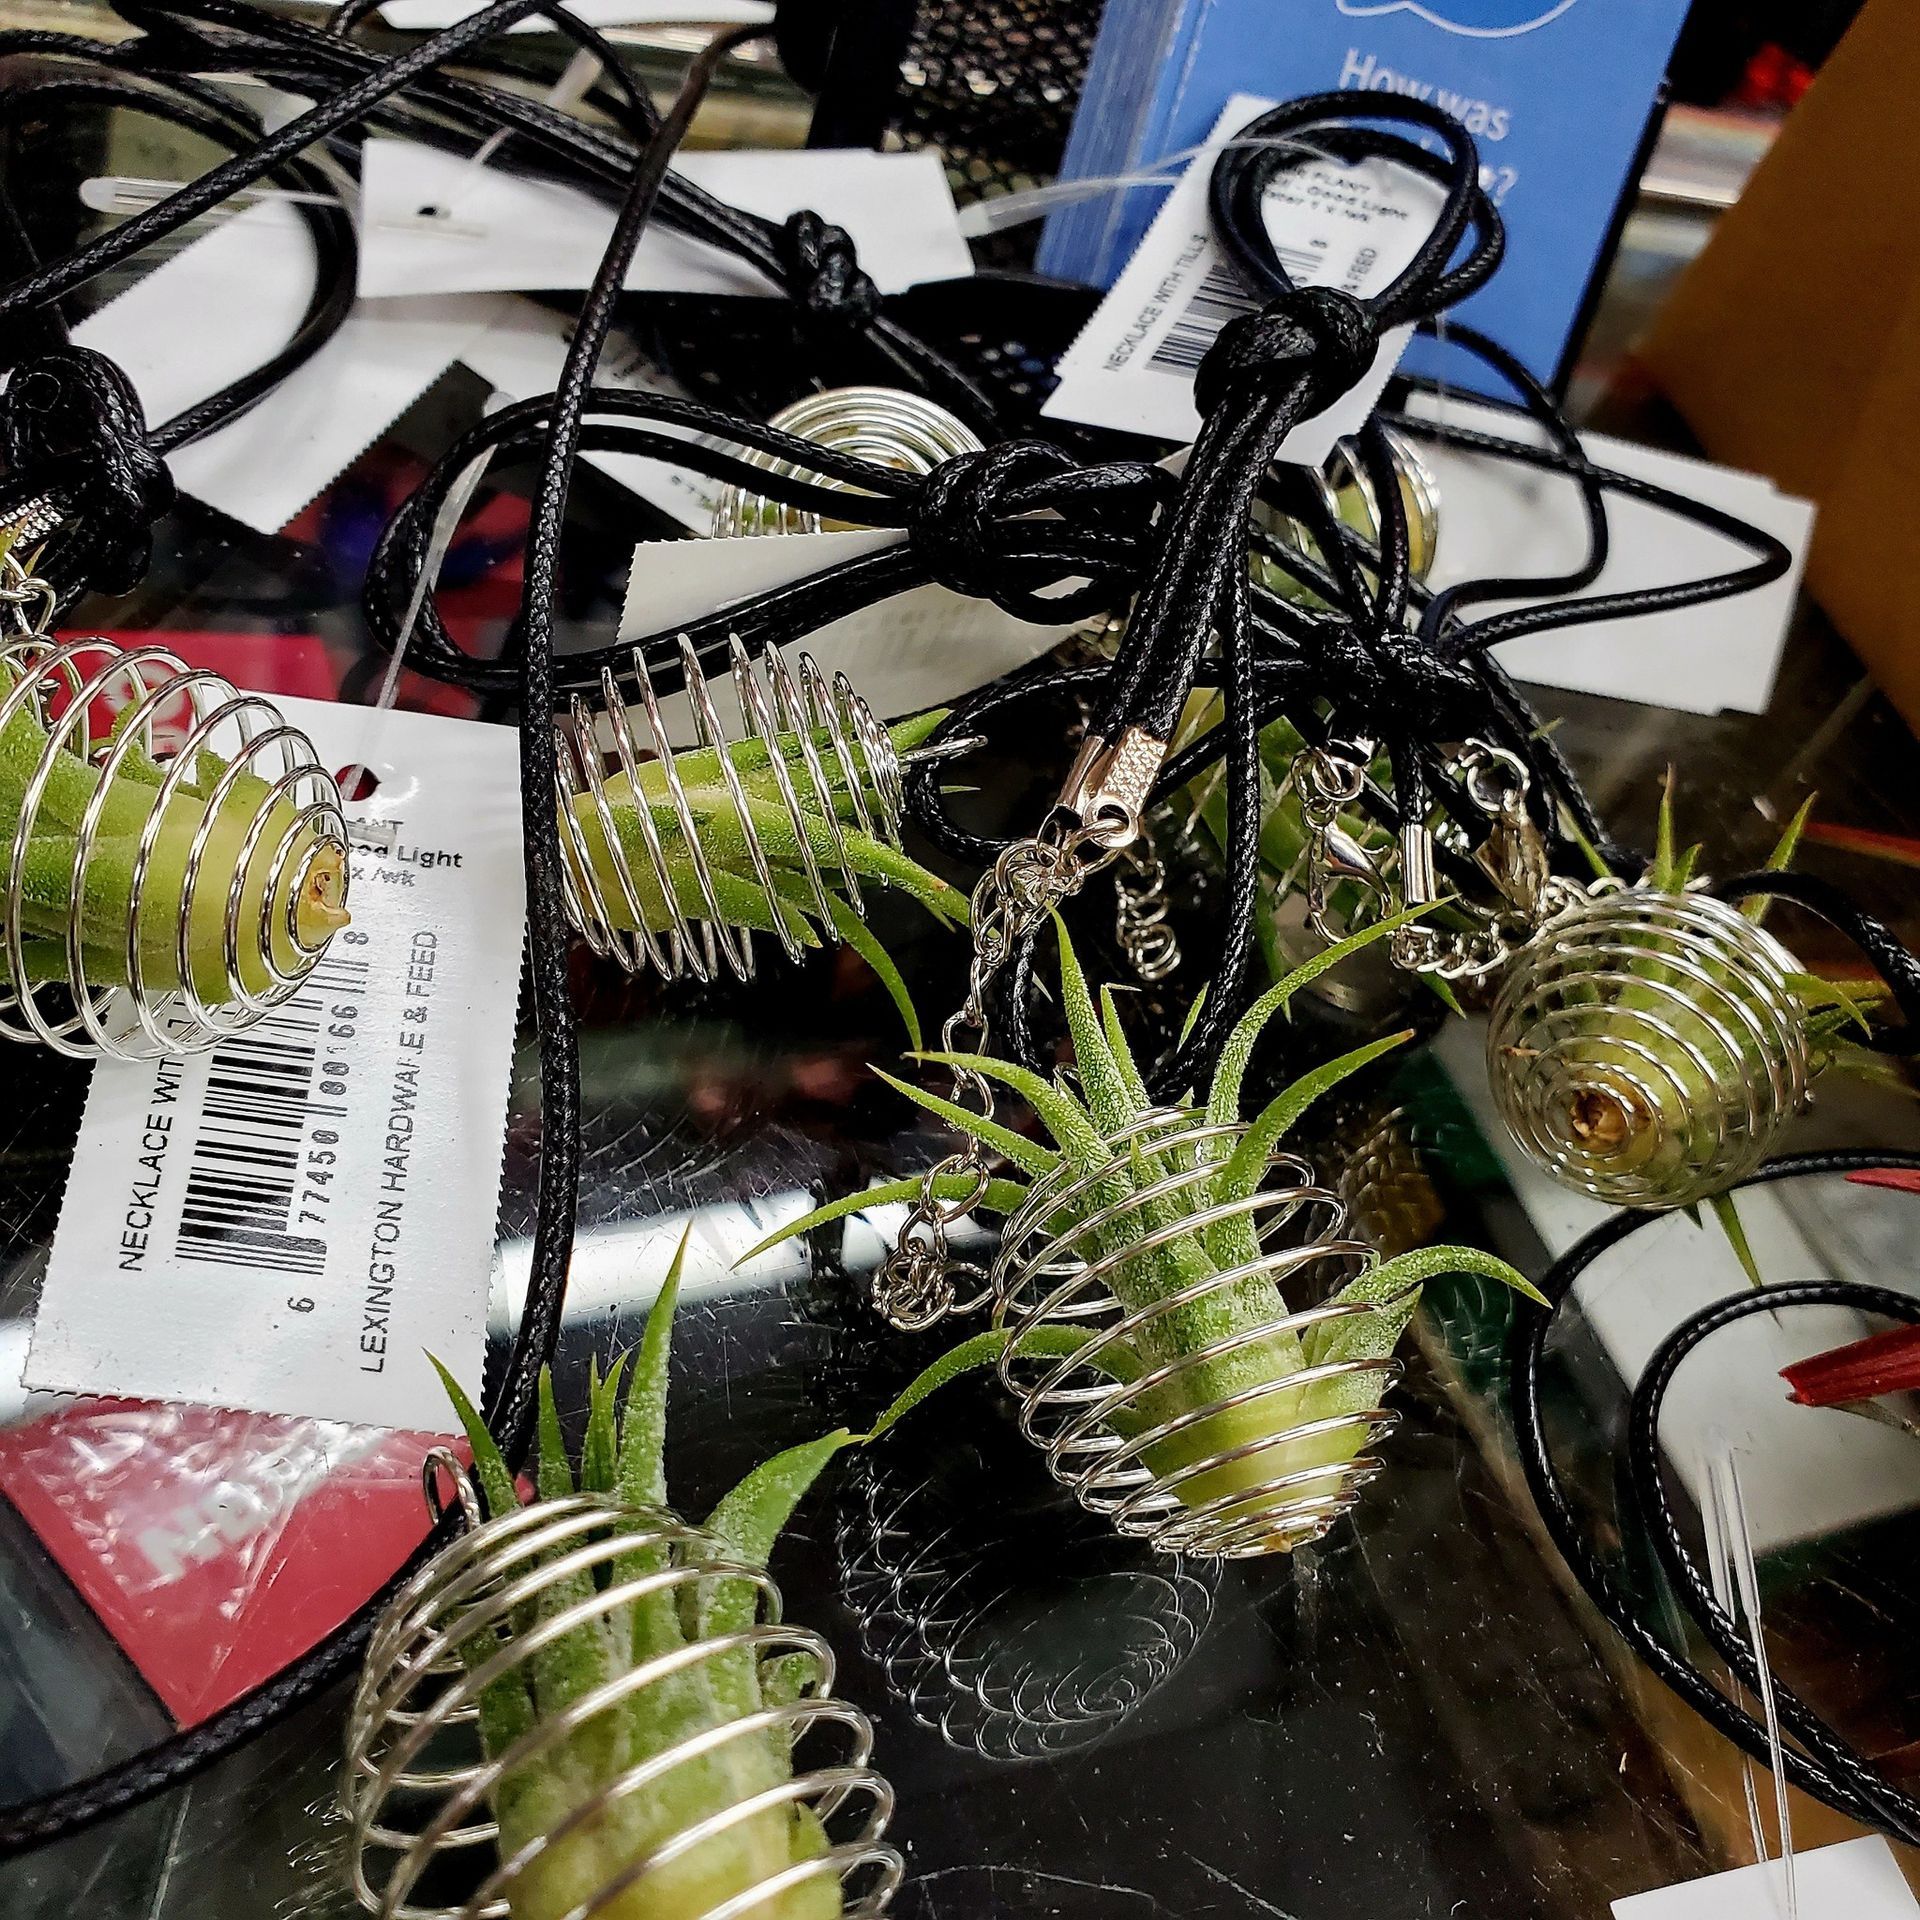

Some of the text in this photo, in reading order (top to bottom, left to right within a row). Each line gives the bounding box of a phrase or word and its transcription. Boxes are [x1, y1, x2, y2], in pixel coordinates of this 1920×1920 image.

[1338, 48, 1511, 142] How was
[1102, 306, 1163, 372] NECKLACE
[1152, 271, 1185, 304] WITH
[397, 845, 463, 868] Light
[342, 930, 370, 946] 8
[405, 930, 439, 998] FEED
[402, 1005, 429, 1024] &
[118, 1113, 174, 1272] NECKLACE
[151, 1056, 185, 1105] WIT
[298, 1129, 339, 1225] 77450
[286, 1296, 316, 1314] 6
[359, 1200, 405, 1374] LEXINGTON
